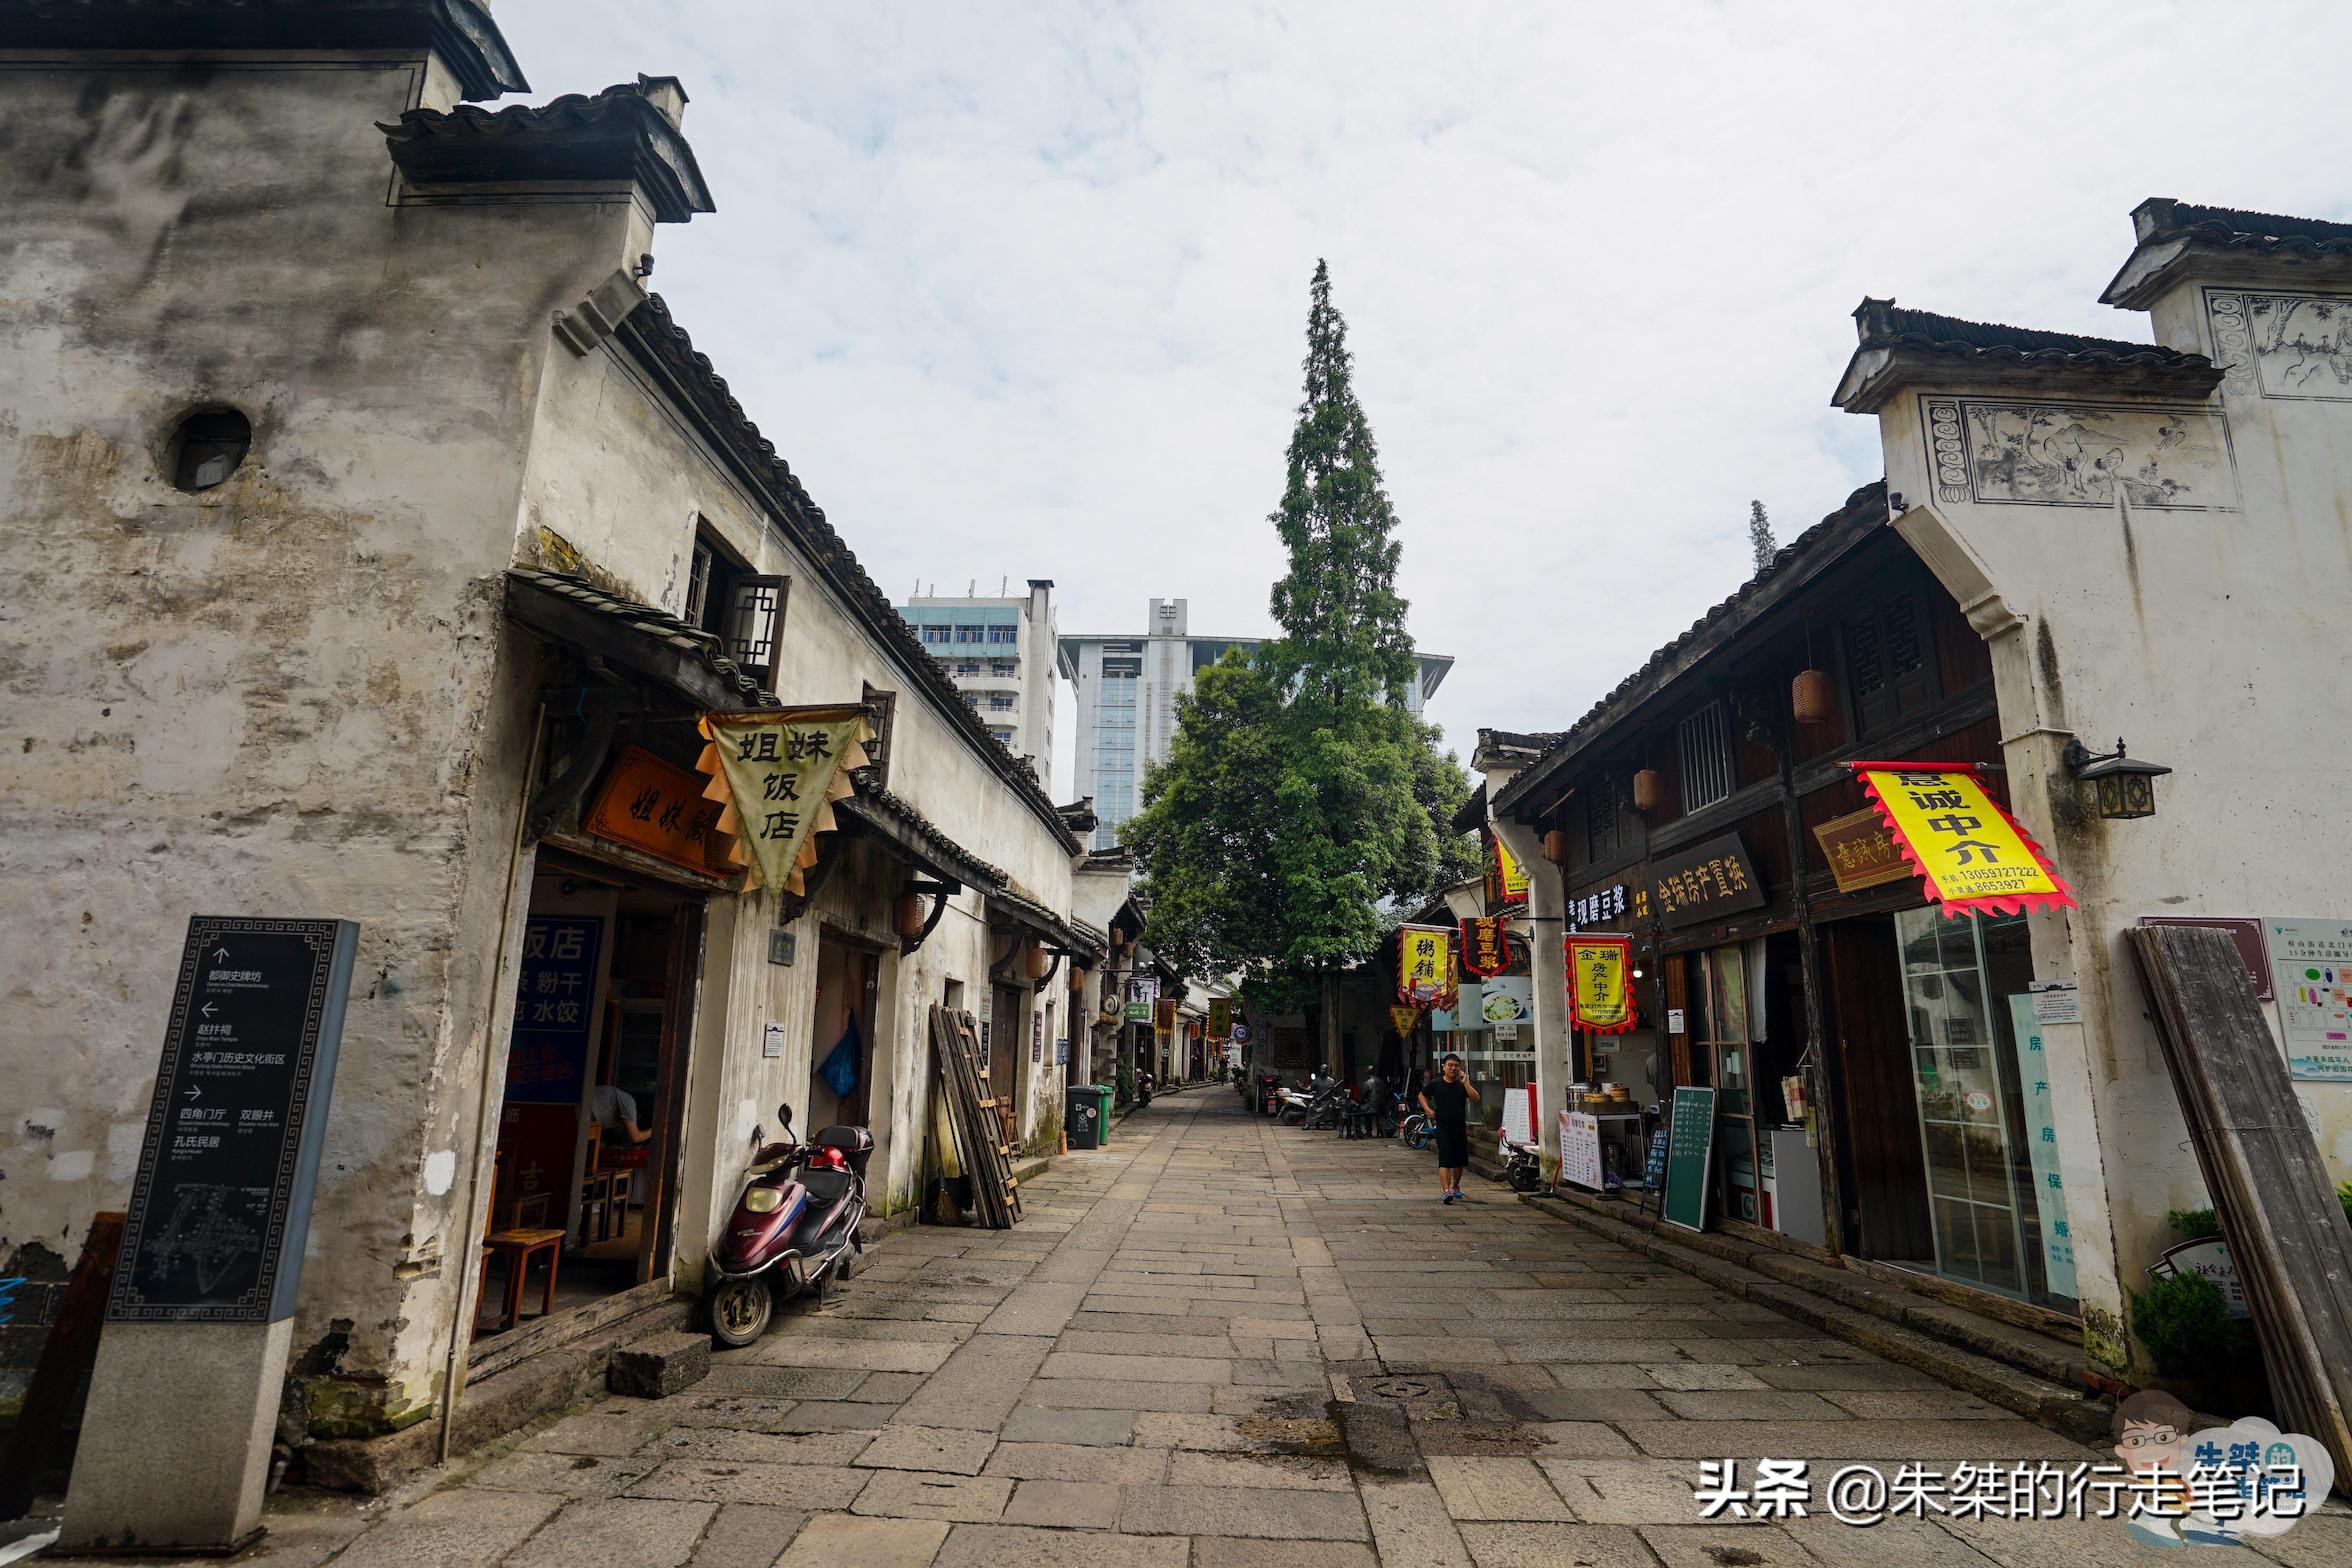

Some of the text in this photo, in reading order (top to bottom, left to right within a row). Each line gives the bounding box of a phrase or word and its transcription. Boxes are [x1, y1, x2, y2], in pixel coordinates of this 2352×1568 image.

[736, 731, 833, 763] 姐妹
[759, 772, 801, 841] 饭店
[1576, 884, 1625, 926] 现磨豆浆
[1475, 917, 1499, 969] 现磨豆浆
[1578, 949, 1618, 961] 金瑞
[208, 970, 262, 983] 都御史牌坊
[1592, 962, 1610, 1002] 房产中介
[532, 999, 580, 1024] 水饺
[192, 1051, 286, 1065] 水亭门历史文化街区
[180, 1108, 275, 1121] 四角门厅 双眼井
[173, 1136, 221, 1148] 孔氏民居
